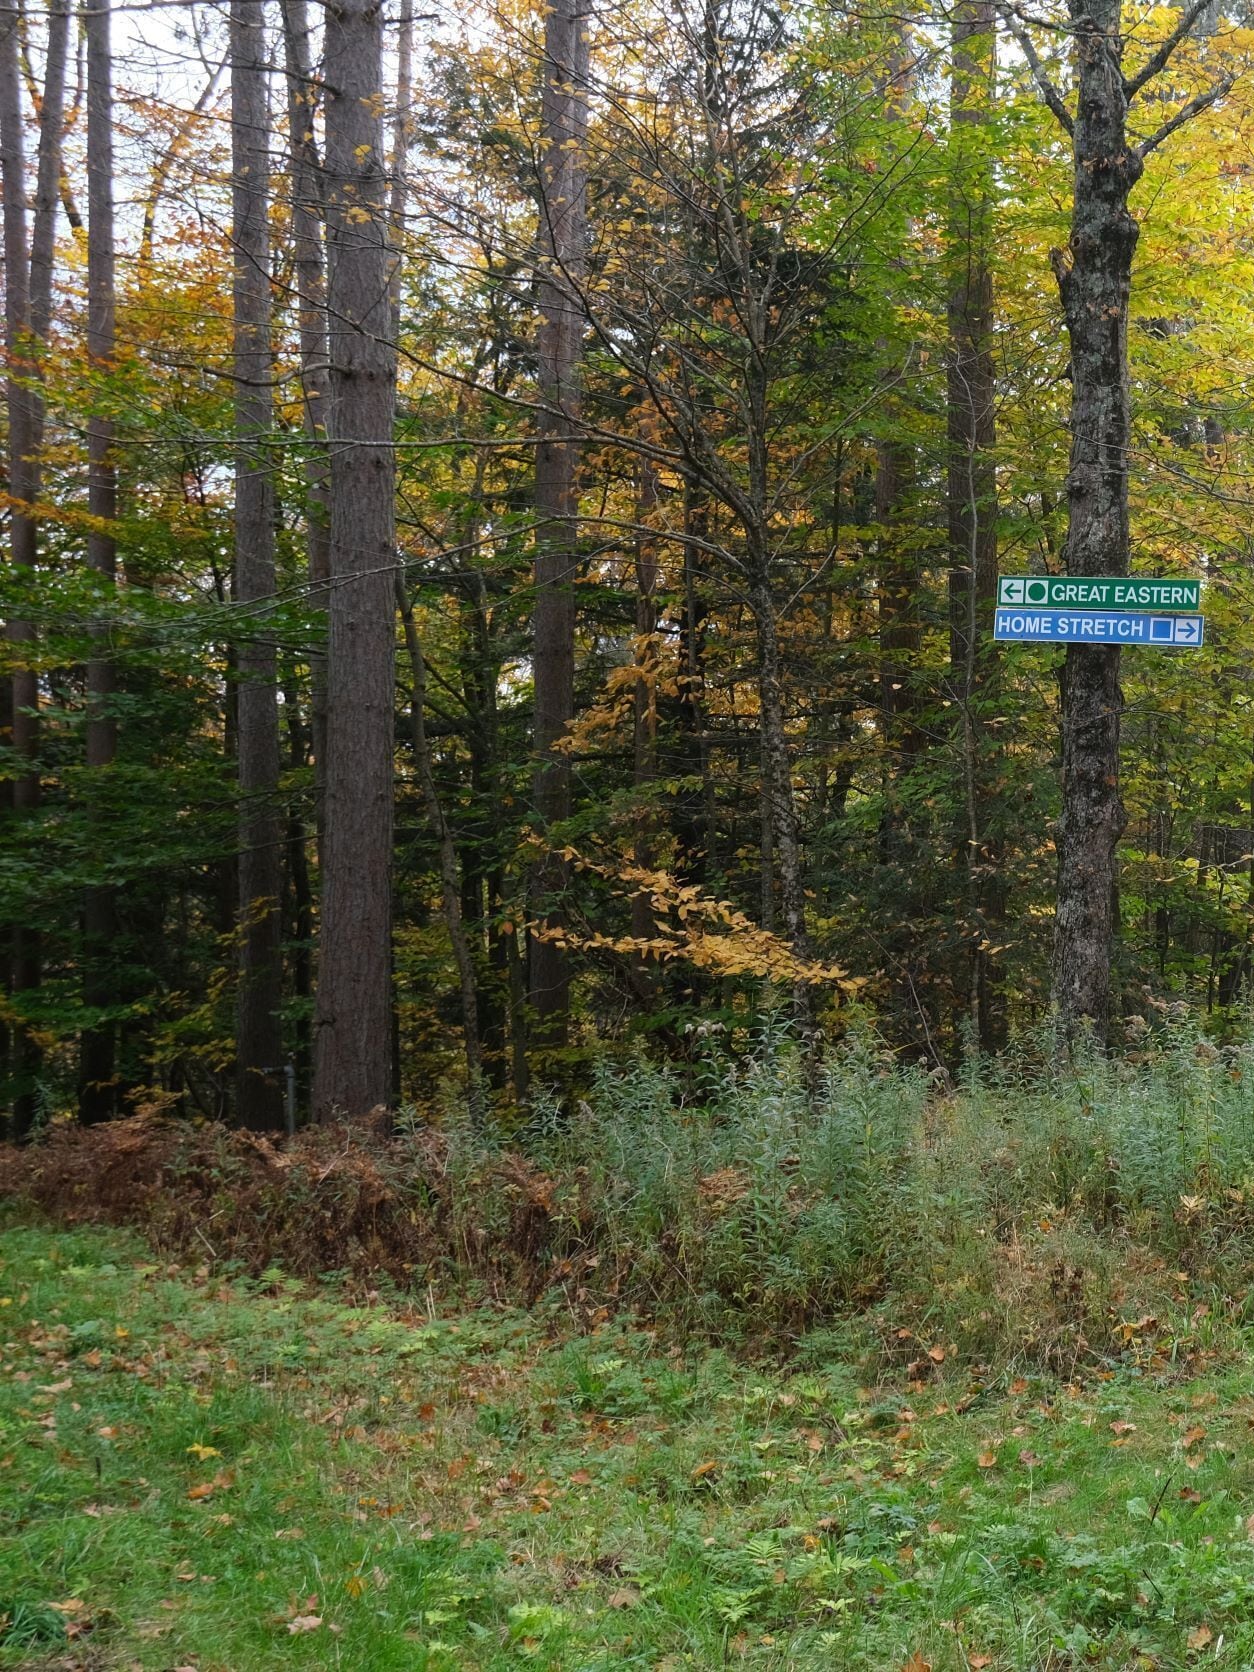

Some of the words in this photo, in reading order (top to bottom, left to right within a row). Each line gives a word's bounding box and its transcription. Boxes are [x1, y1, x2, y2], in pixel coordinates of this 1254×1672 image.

[1051, 584, 1110, 602] GREAT
[1115, 586, 1197, 604] EASTERN
[999, 616, 1052, 634] HOME
[1057, 617, 1143, 636] STRETCH
